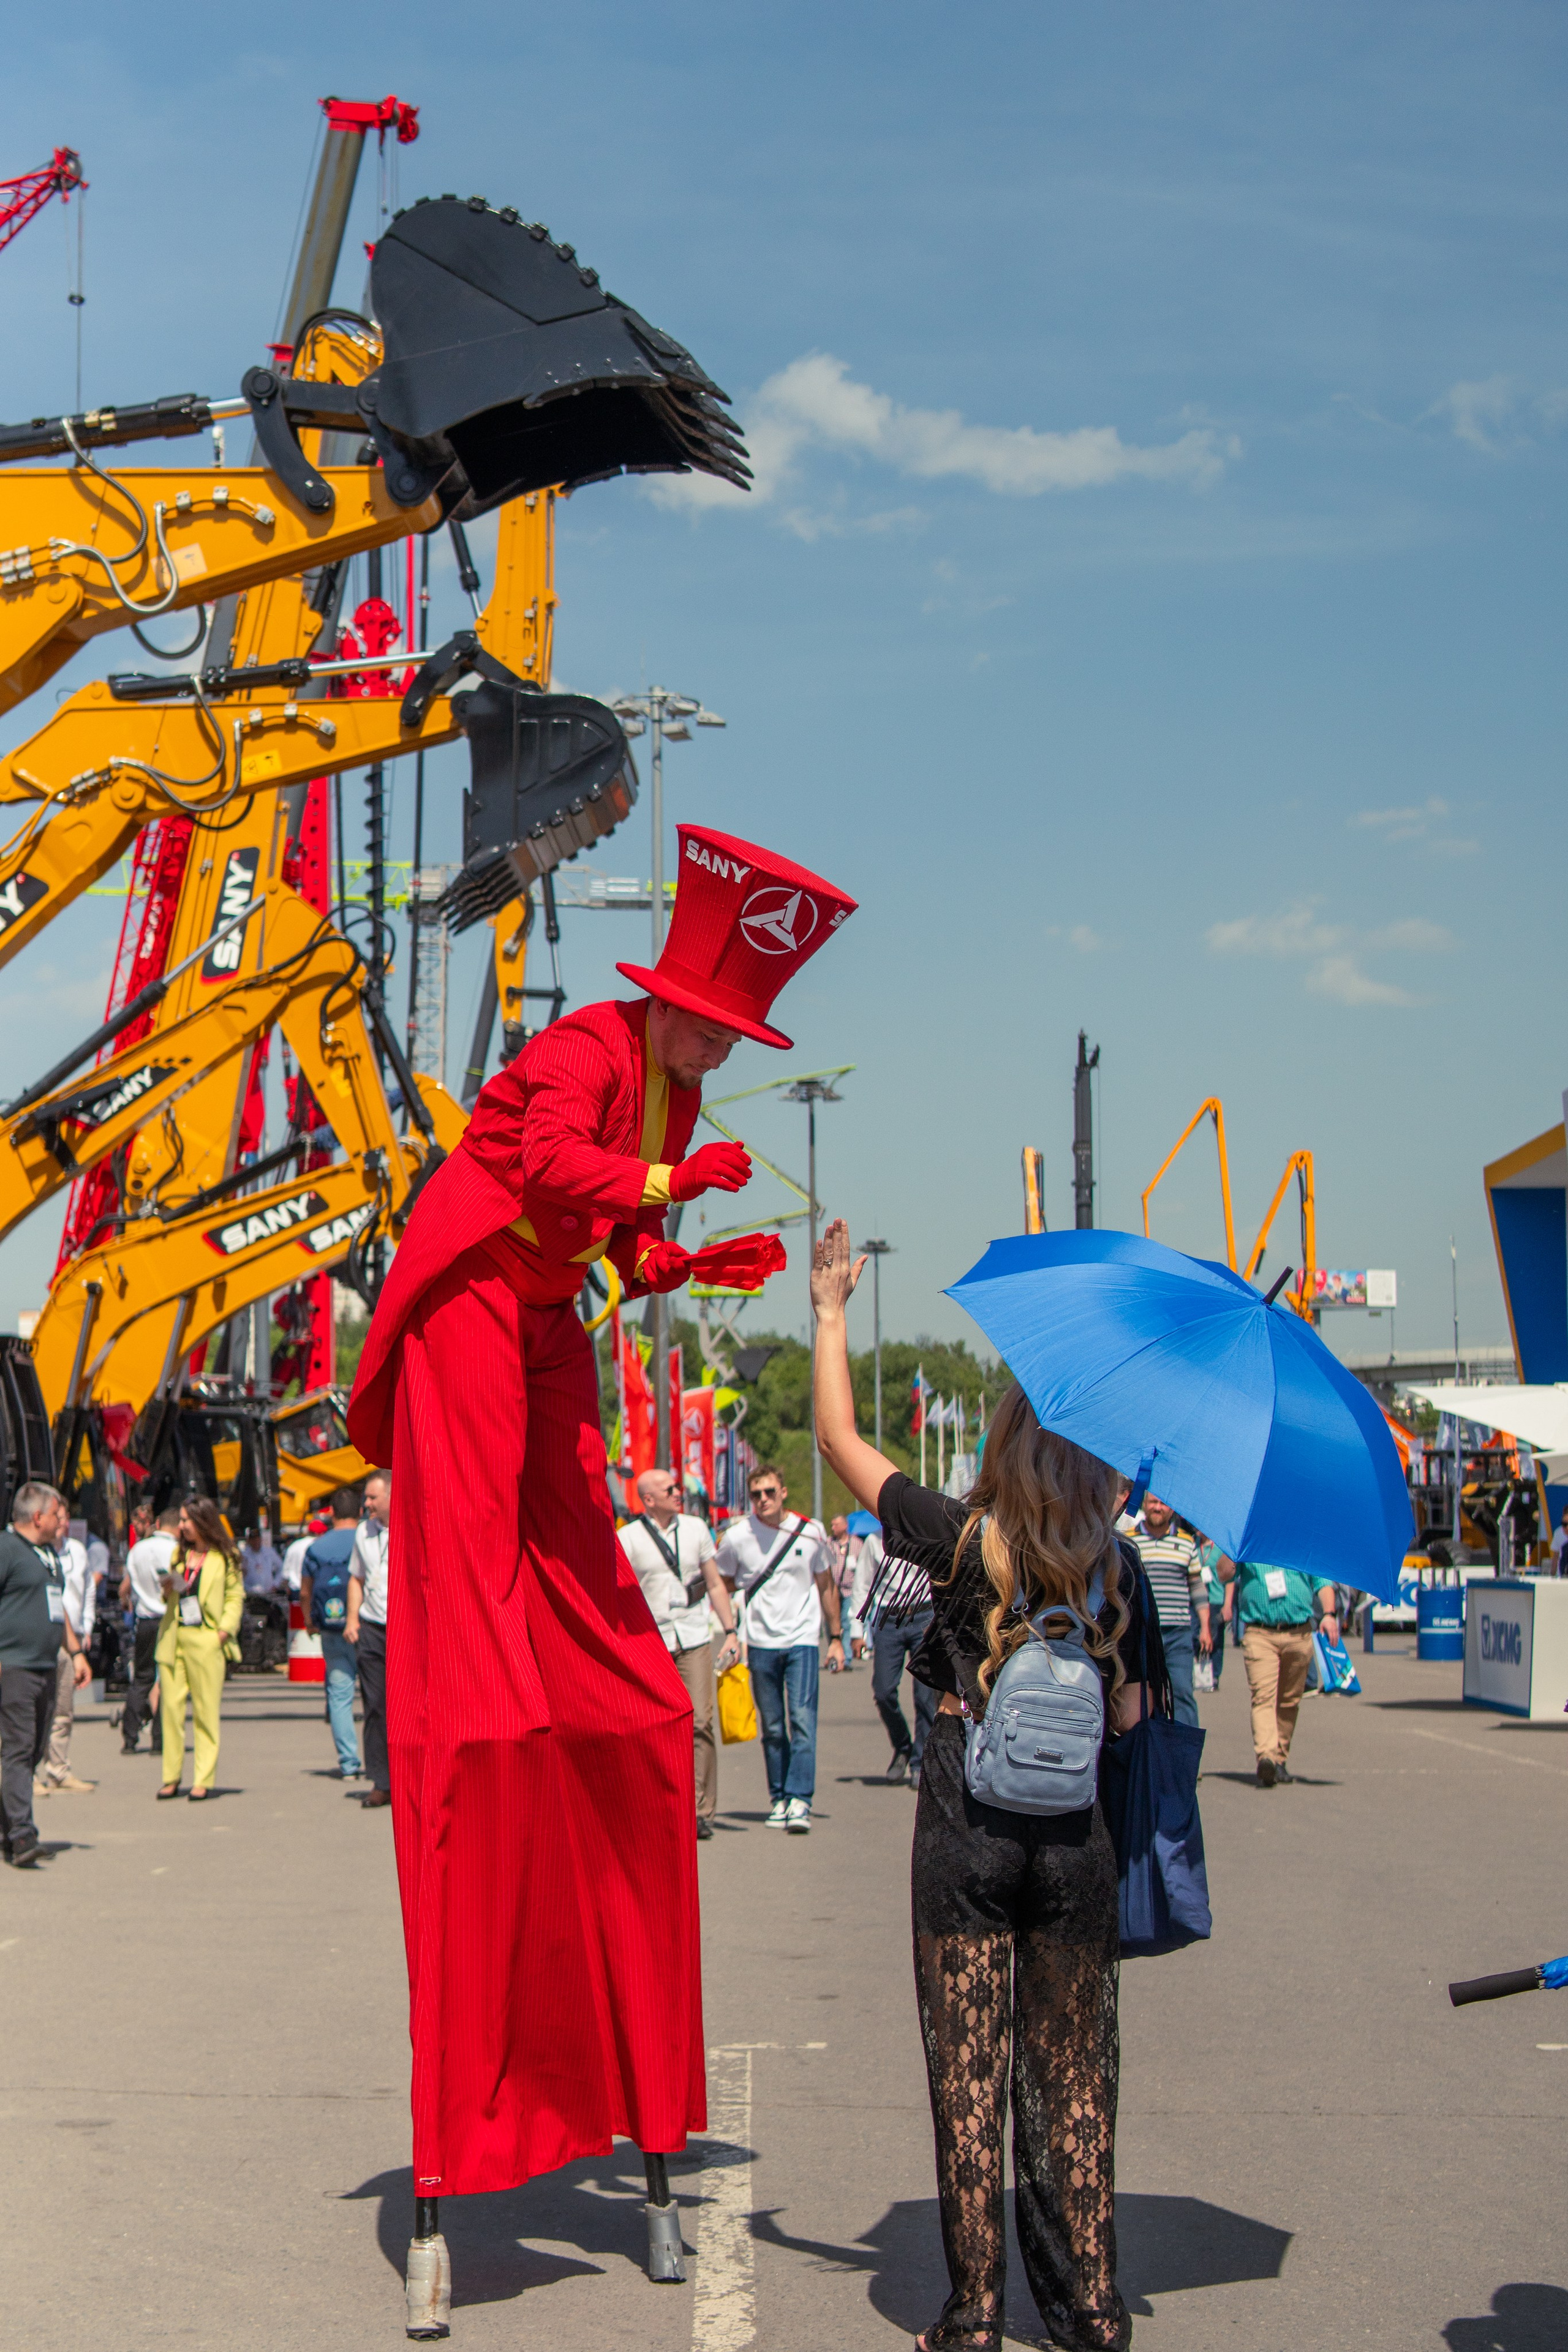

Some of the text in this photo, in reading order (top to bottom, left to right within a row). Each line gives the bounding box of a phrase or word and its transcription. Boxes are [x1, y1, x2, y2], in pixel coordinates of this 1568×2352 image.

[685, 839, 751, 884] SANY
[212, 859, 254, 970] SANY
[93, 1066, 153, 1121] SANY
[221, 1192, 309, 1254] SANY
[309, 1203, 373, 1253] SAN
